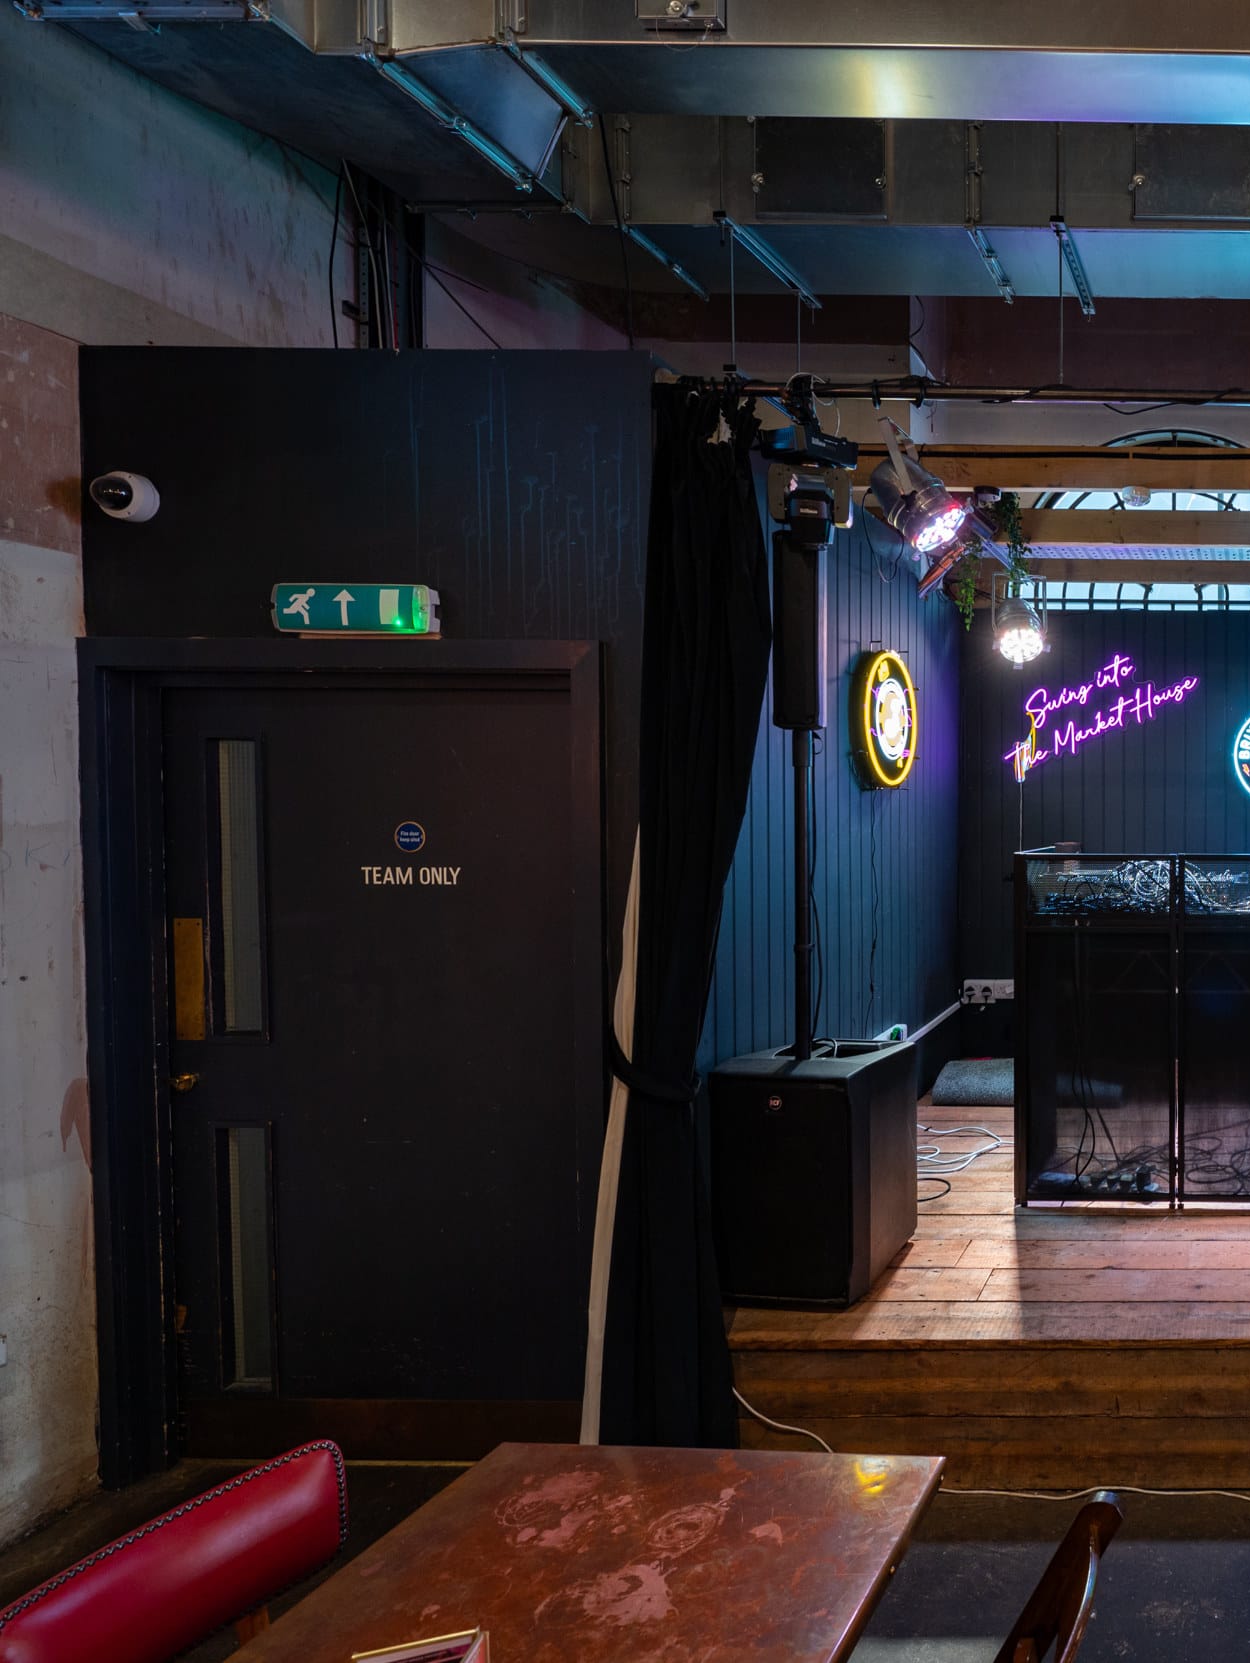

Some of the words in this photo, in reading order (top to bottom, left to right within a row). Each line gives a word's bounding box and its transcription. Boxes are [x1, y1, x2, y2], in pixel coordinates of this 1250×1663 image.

[1025, 684, 1093, 728] Swing
[1096, 654, 1133, 687] into
[1053, 696, 1134, 755] Market
[1130, 677, 1198, 724] House
[361, 866, 413, 885] TEAM
[419, 866, 461, 885] ONLY
